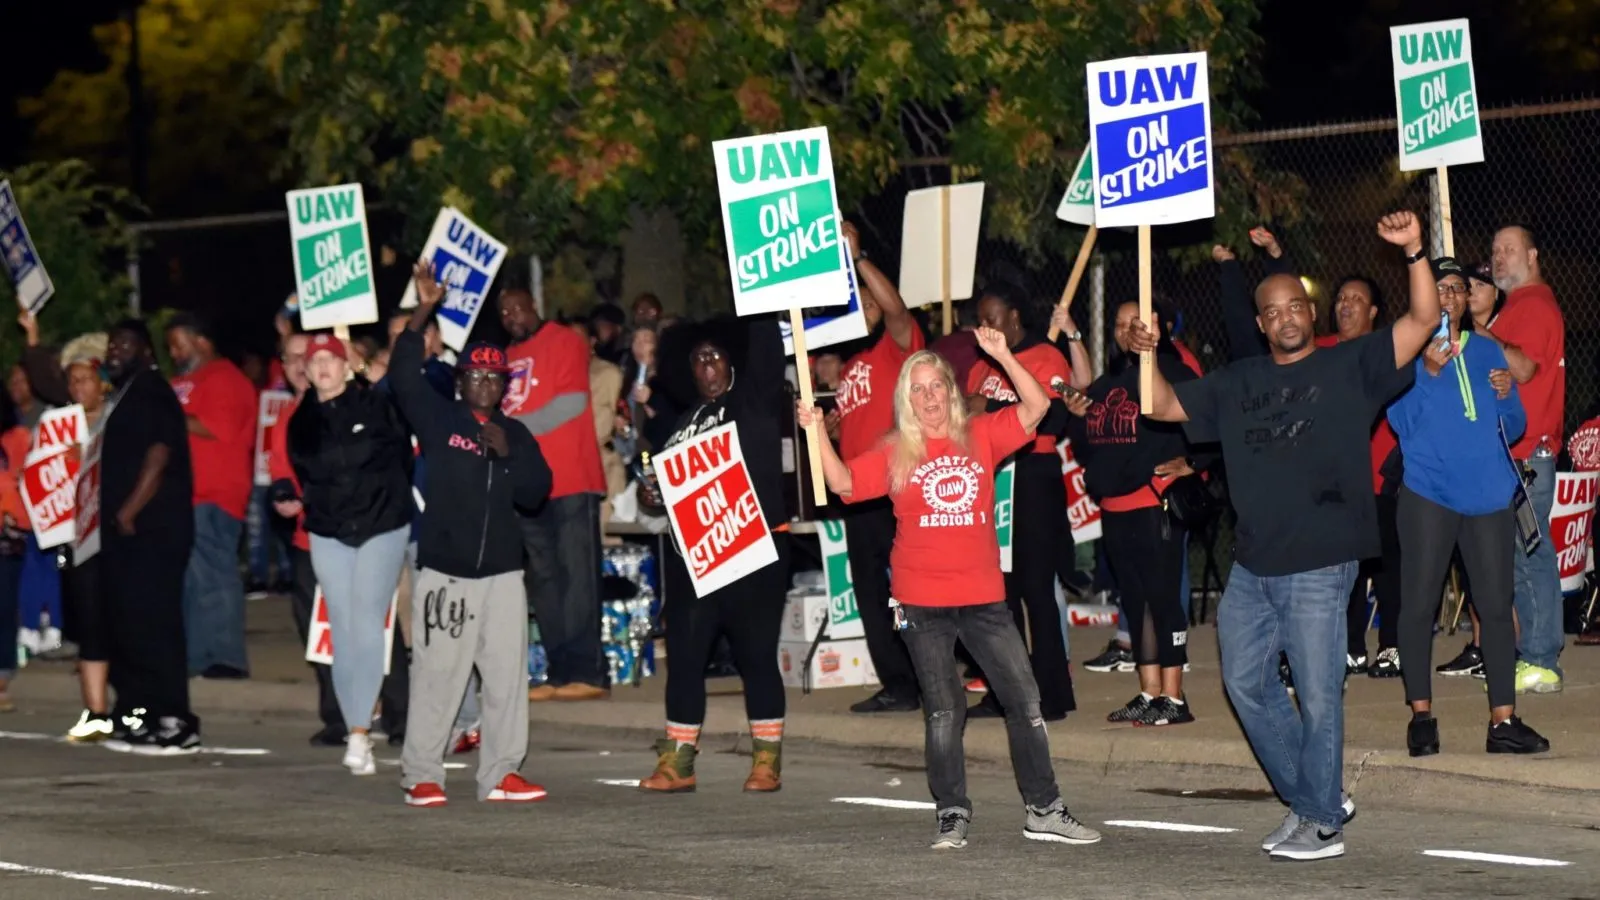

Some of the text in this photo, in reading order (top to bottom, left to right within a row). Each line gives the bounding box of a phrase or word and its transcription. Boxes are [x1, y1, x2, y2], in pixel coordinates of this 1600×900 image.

[1399, 28, 1463, 65] UAW
[1098, 62, 1197, 107] UAW
[1419, 71, 1447, 110] ON
[1126, 114, 1169, 159] ON
[1403, 90, 1475, 151] STRIKE
[727, 139, 820, 184] UAW
[1100, 136, 1207, 205] STRIKE
[296, 190, 355, 224] UAW
[759, 191, 800, 238] ON
[314, 230, 342, 268] ON
[448, 217, 498, 268] UAW
[737, 213, 837, 289] STRIKE
[302, 248, 368, 307] STRIKE
[440, 259, 473, 289] ON
[39, 415, 78, 447] AW
[39, 453, 69, 492] ON
[663, 431, 732, 487] UAW
[910, 455, 985, 484] PROPERTY OF
[696, 479, 728, 527] ON
[938, 480, 965, 497] UAW
[688, 490, 760, 577] STRIKE
[919, 511, 986, 528] REGION 1
[1564, 511, 1588, 546] ON
